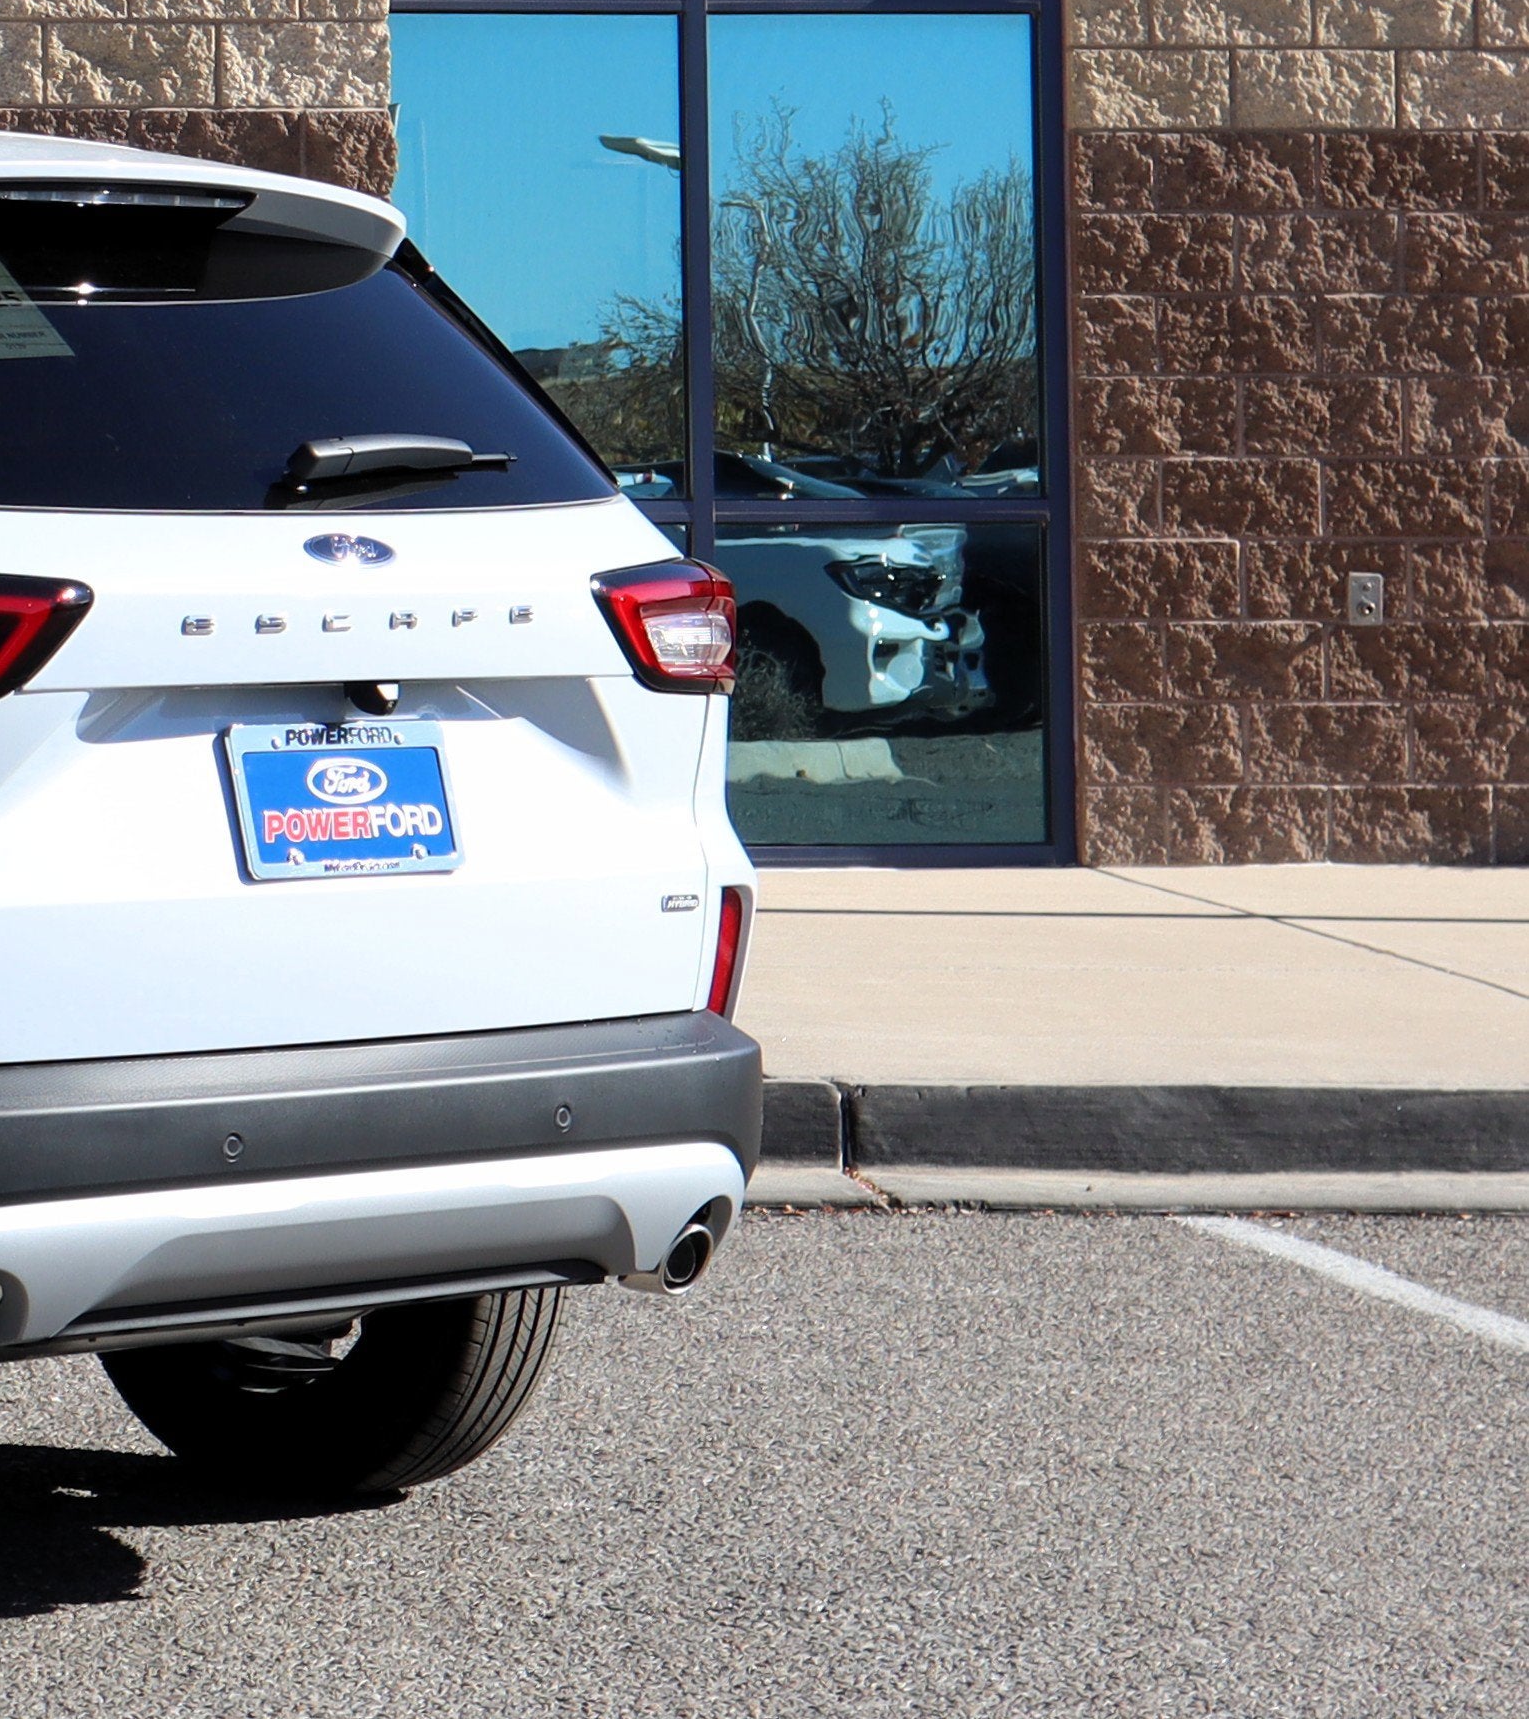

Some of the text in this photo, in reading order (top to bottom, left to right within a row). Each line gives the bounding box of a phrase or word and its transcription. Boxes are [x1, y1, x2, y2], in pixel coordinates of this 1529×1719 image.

[6, 330, 45, 340] NUMBER
[181, 605, 534, 635] ESCAPE
[285, 726, 392, 746] POWERFORD
[323, 765, 371, 794] Ford
[263, 804, 443, 843] POWERFORD
[667, 899, 698, 908] HYBRID
